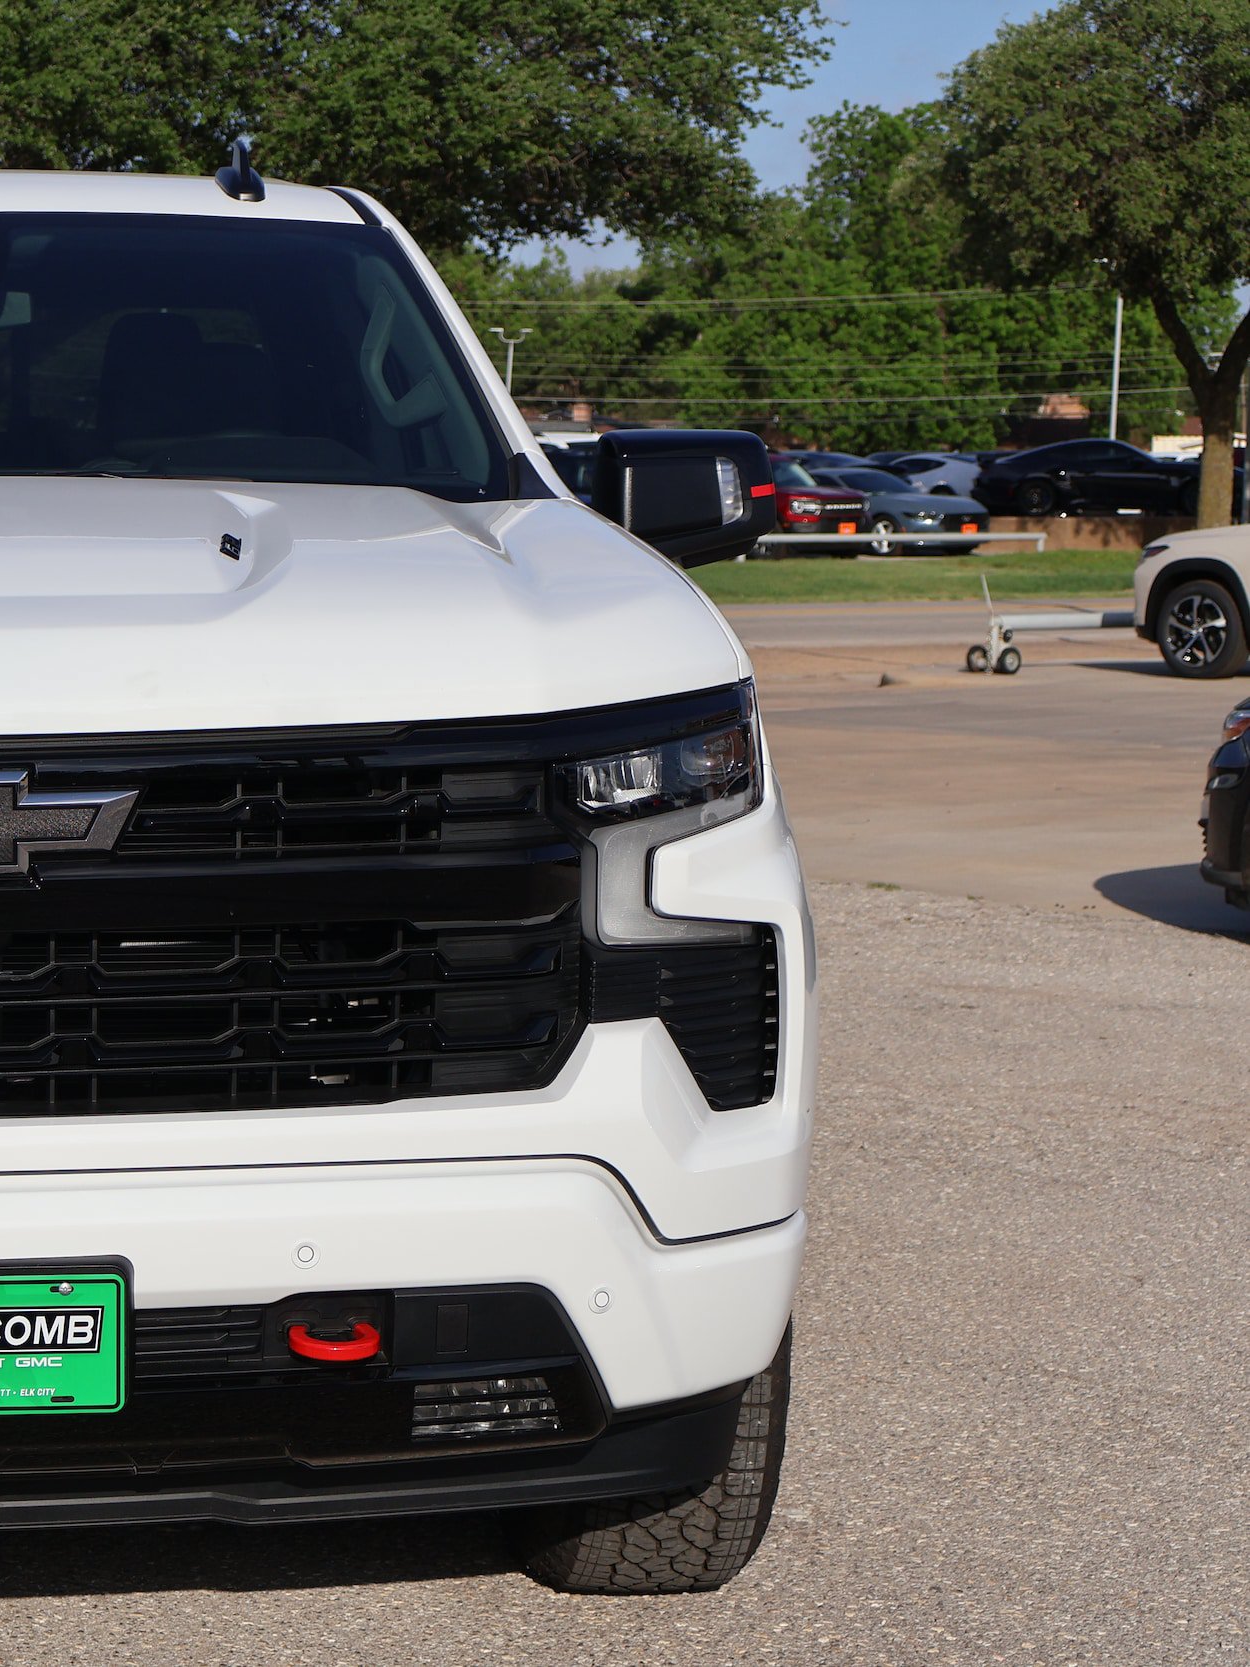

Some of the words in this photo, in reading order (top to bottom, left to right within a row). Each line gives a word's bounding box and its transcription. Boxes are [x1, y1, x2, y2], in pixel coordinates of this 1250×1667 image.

[15, 1356, 63, 1368] GMC
[19, 1388, 35, 1397] ELK
[36, 1387, 56, 1396] CITY
